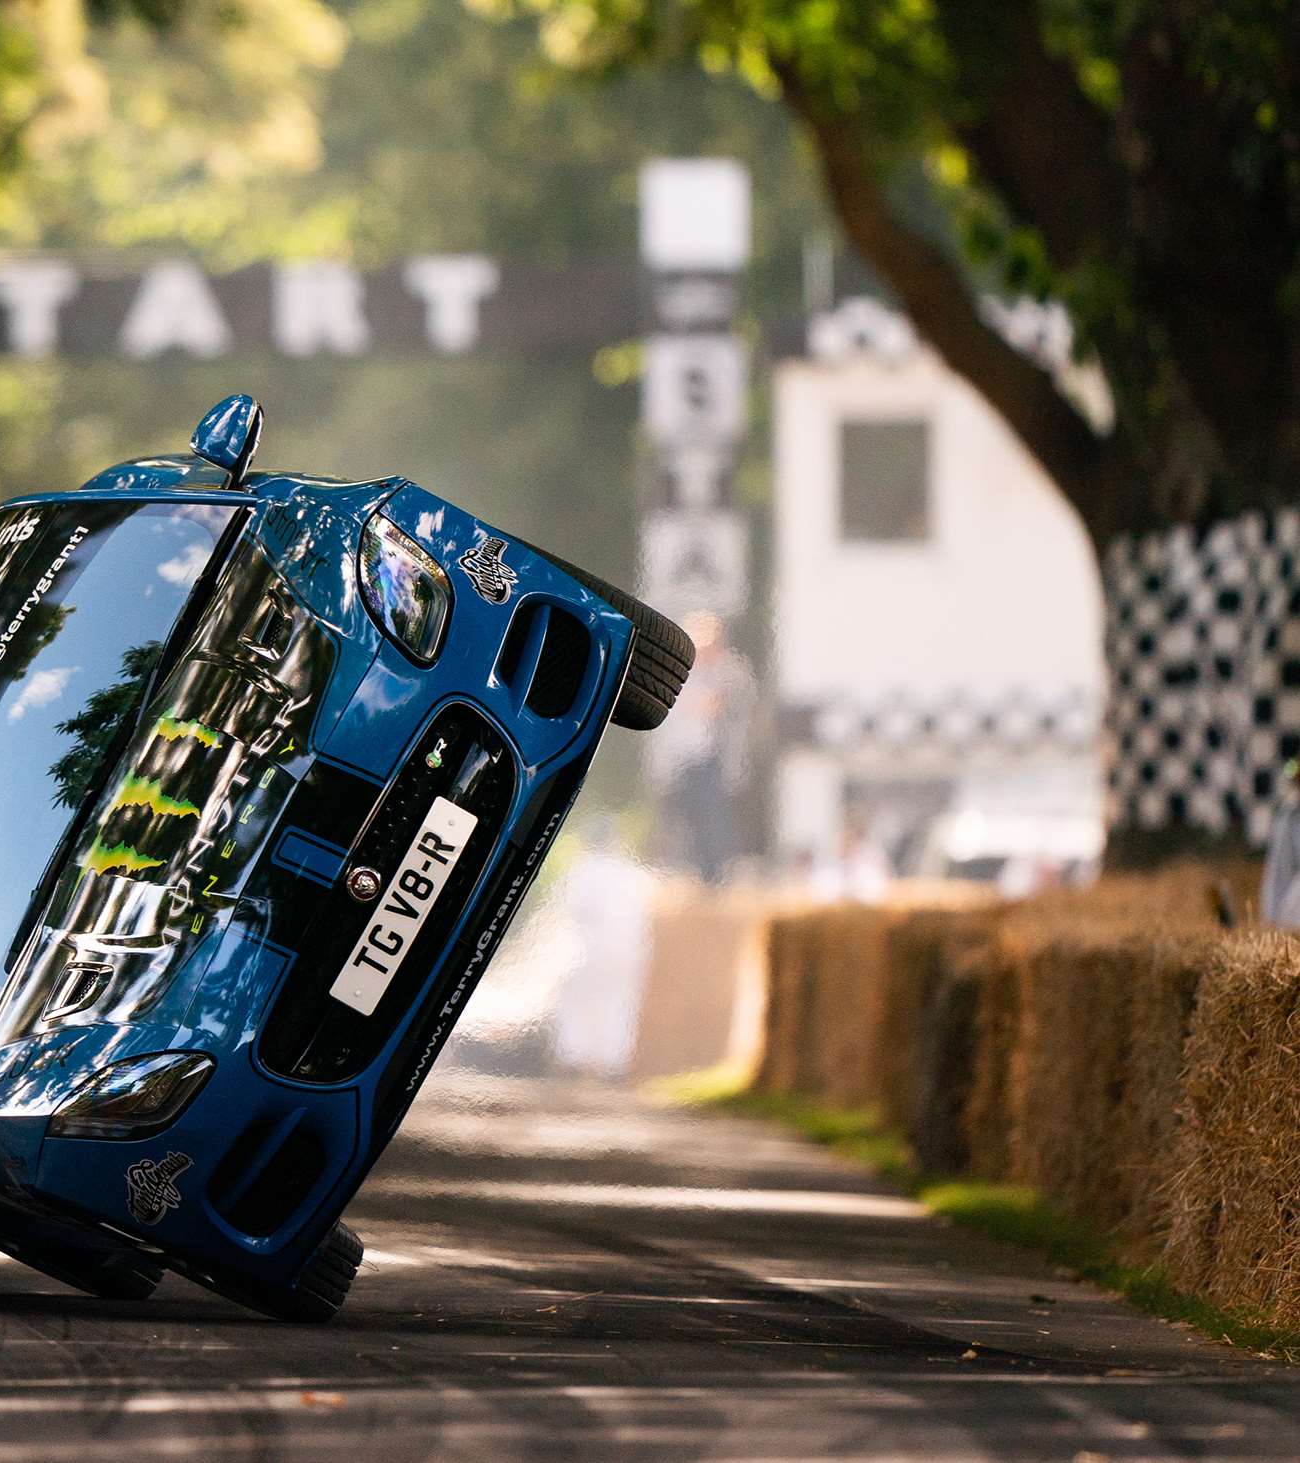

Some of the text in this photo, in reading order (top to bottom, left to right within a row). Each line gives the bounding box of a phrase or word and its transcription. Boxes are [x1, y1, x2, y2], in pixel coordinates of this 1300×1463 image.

[190, 737, 296, 935] ENERGY
[352, 831, 456, 975] TG V8-R
[405, 811, 561, 1092] www.TerryGrant.com
